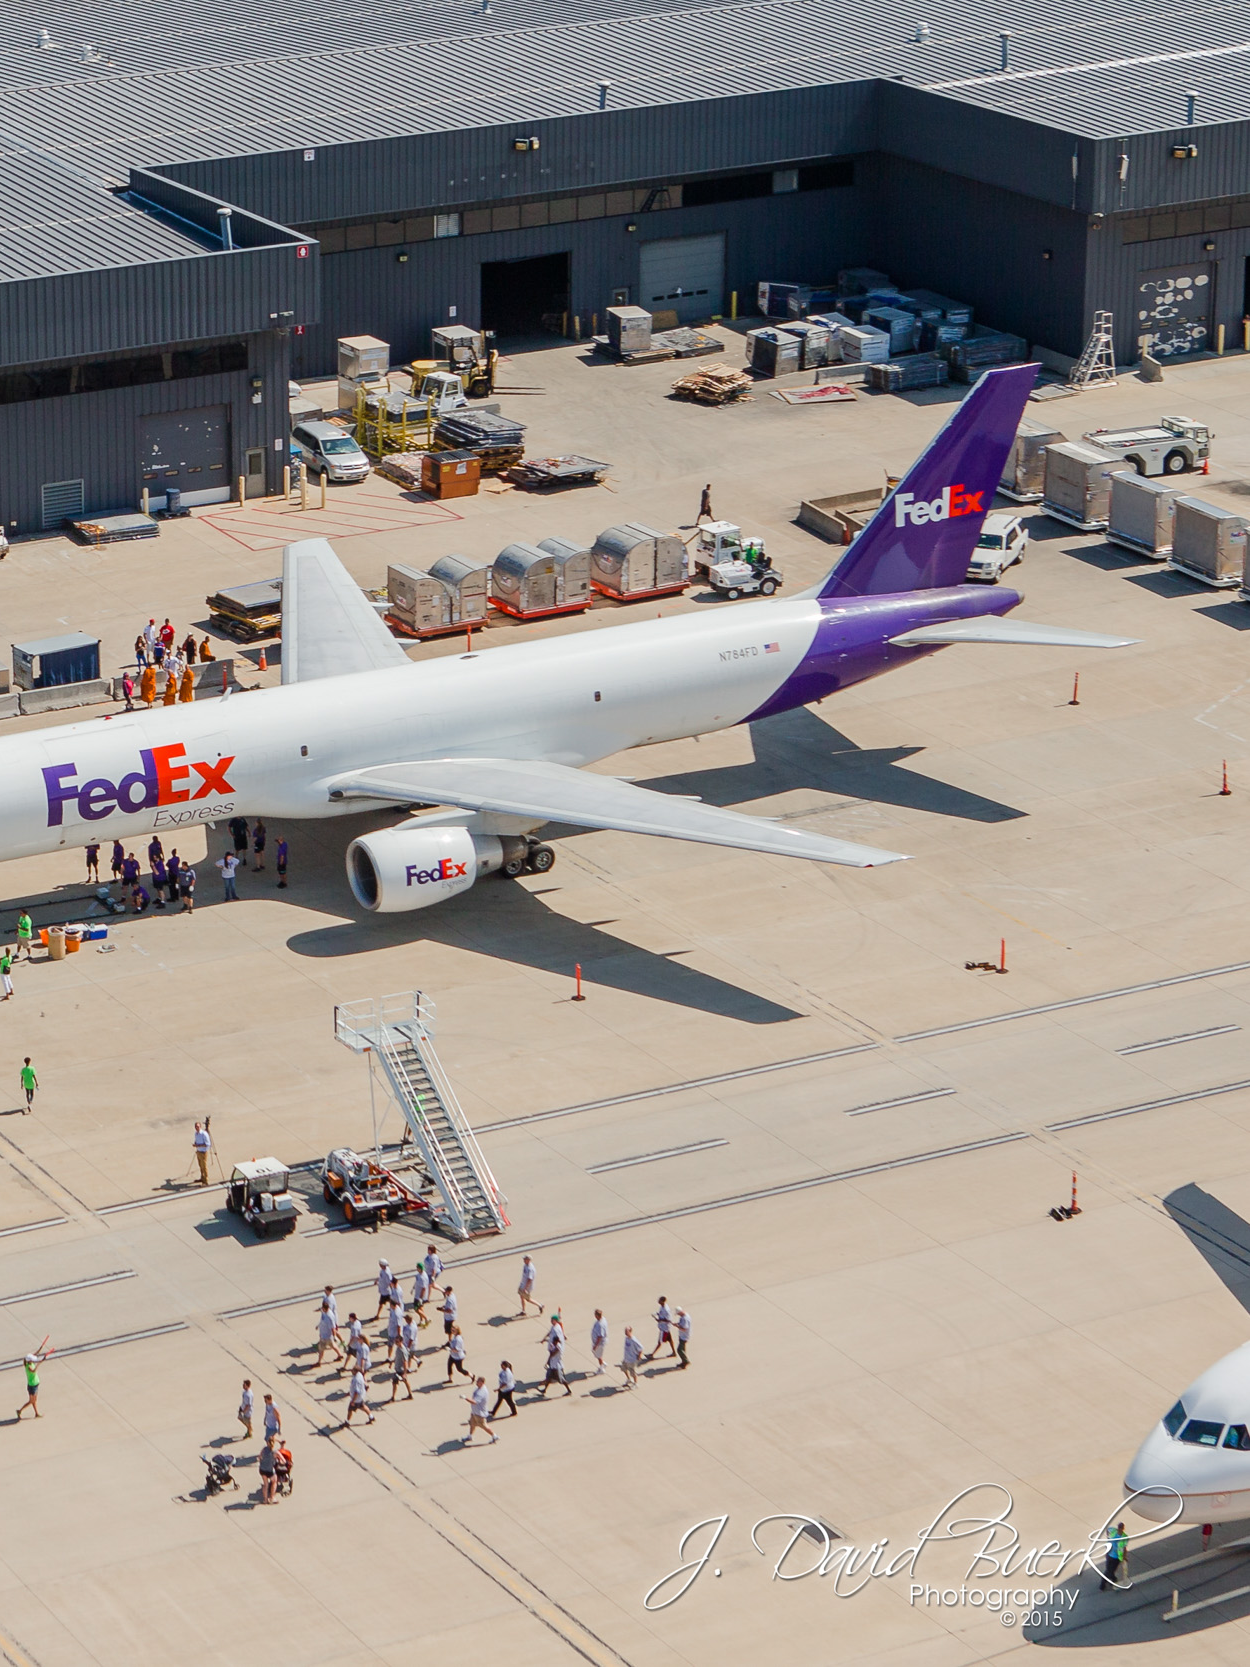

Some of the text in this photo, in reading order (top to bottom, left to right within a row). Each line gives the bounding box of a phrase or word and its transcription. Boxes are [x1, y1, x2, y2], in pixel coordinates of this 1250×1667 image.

[895, 484, 984, 527] FedEx
[41, 743, 236, 827] FedEx
[154, 802, 235, 827] Express
[406, 858, 467, 886] FedEx
